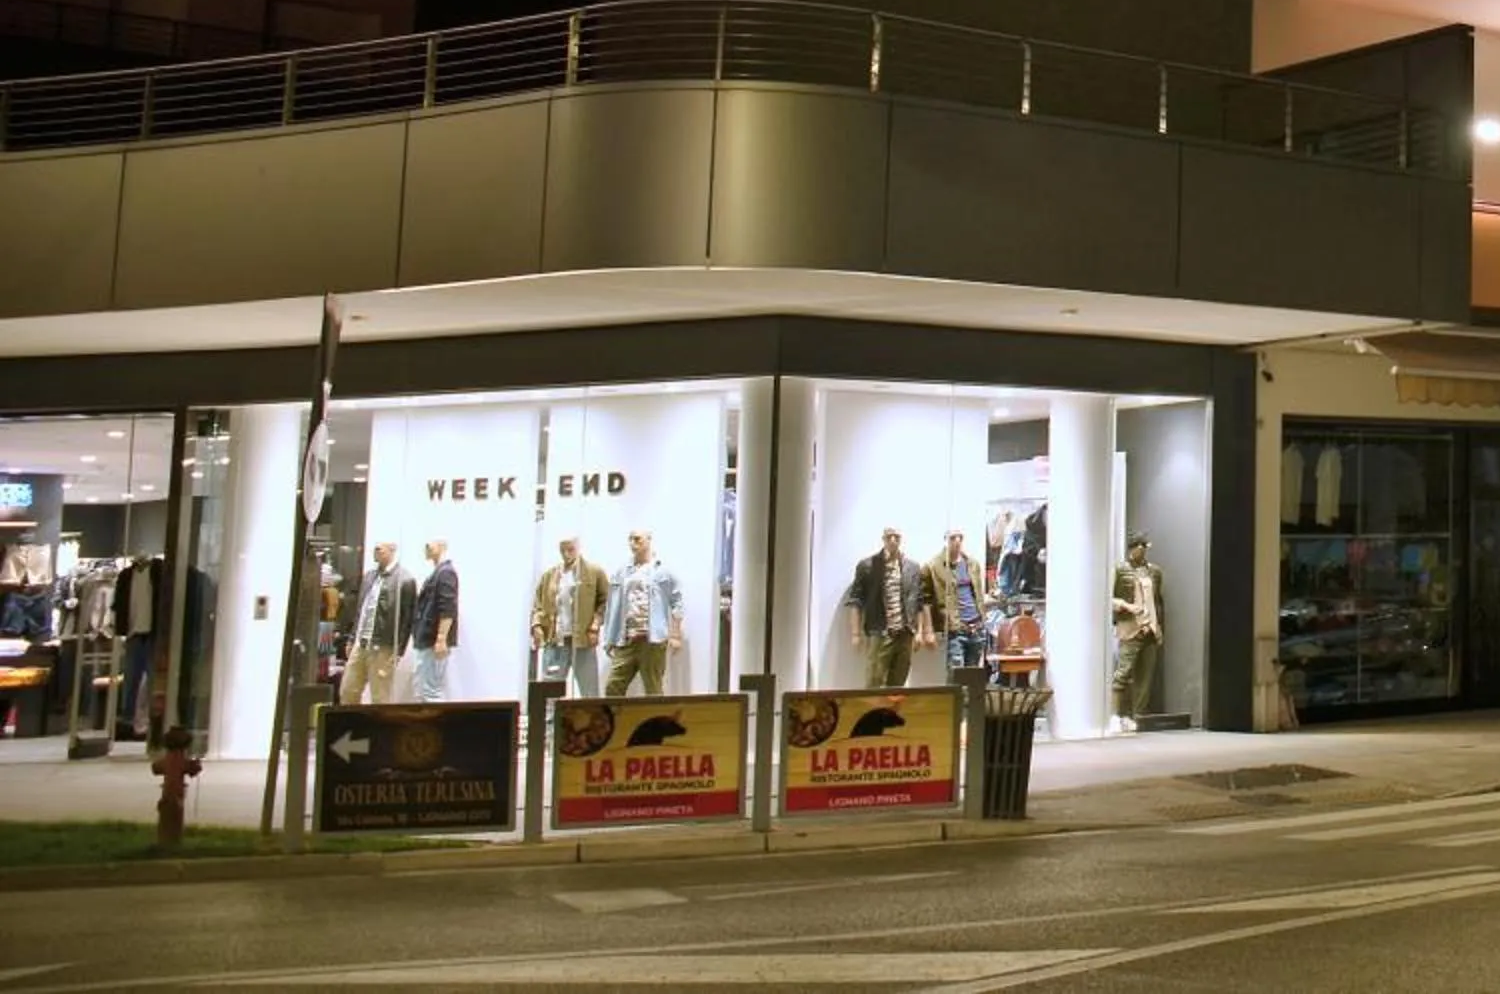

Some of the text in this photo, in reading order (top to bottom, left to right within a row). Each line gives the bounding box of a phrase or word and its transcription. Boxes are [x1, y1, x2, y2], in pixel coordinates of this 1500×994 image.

[427, 477, 517, 501] WEEK
[585, 754, 715, 782] LA PAELLA
[811, 744, 931, 772] LA PAELLA
[334, 783, 407, 805] OSTERIA
